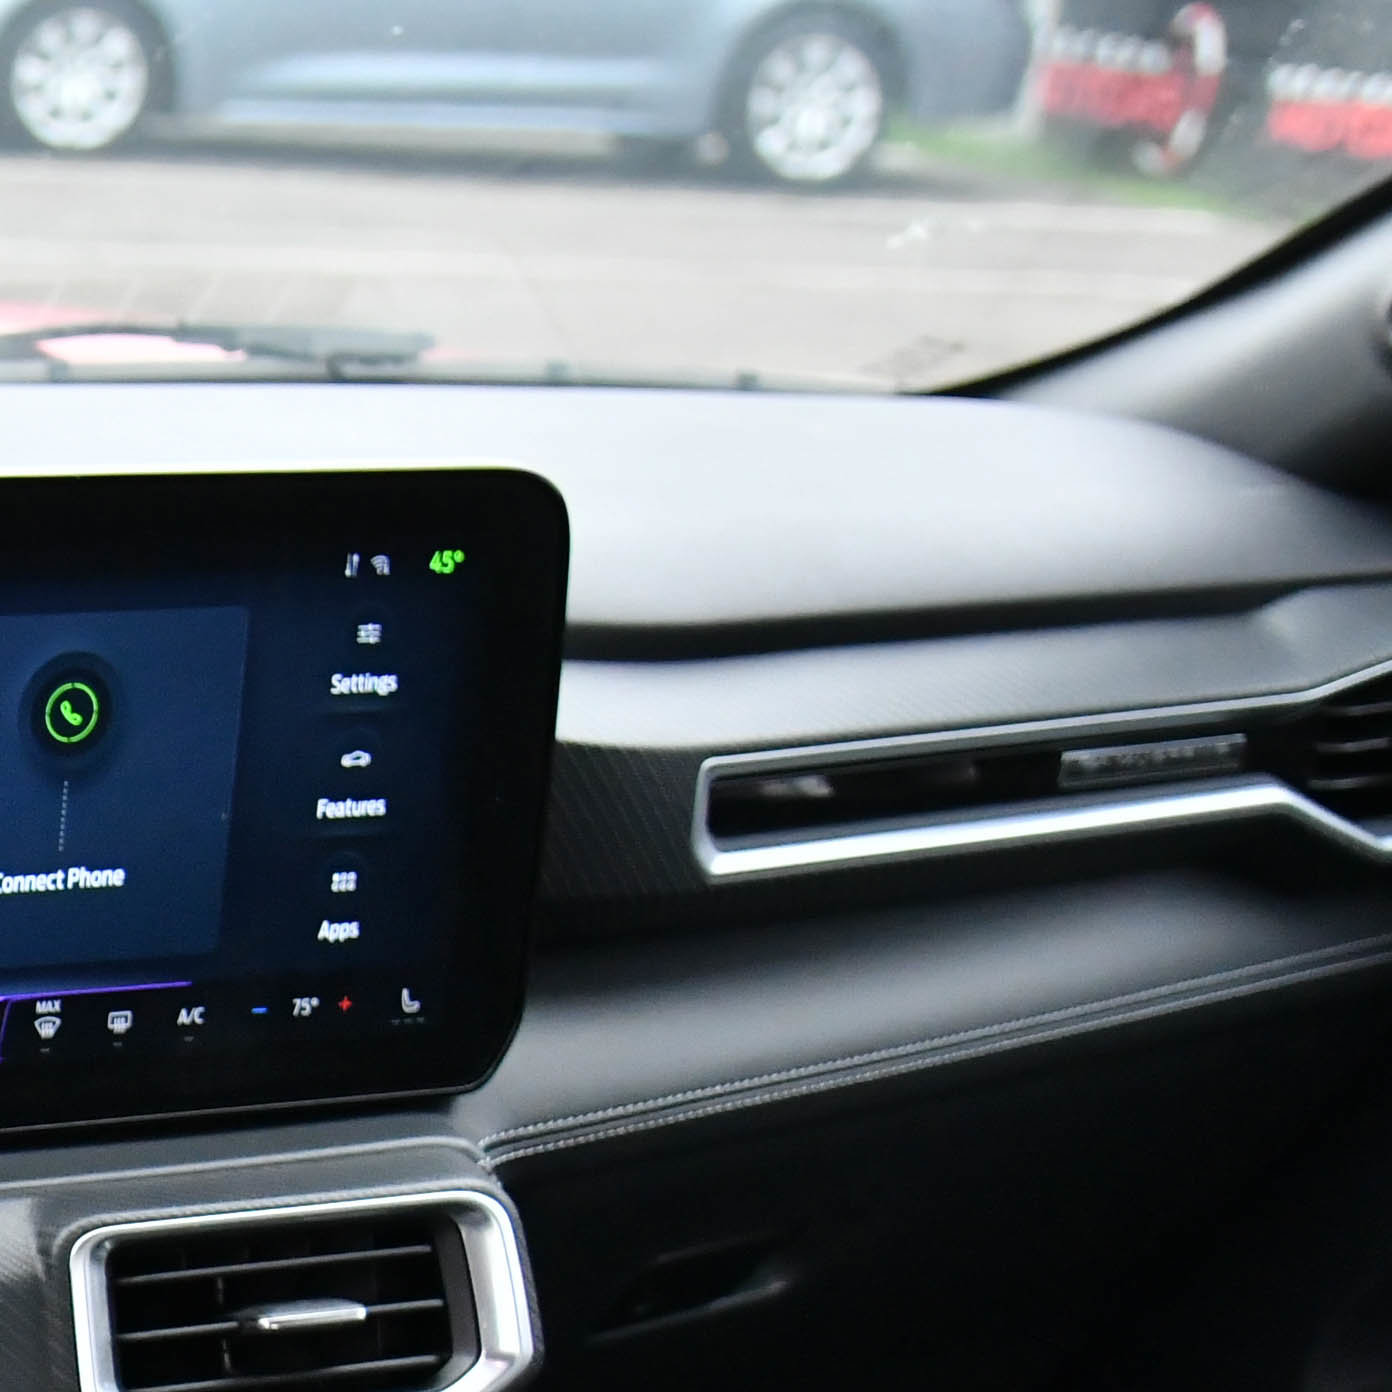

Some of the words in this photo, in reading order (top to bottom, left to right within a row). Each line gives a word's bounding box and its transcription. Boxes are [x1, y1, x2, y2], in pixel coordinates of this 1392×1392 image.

[330, 672, 398, 696] Settings
[316, 797, 386, 820] Features
[67, 864, 125, 890] Phone
[317, 920, 360, 942] Apps
[35, 1000, 61, 1014] MAX
[177, 1006, 205, 1027] A/C
